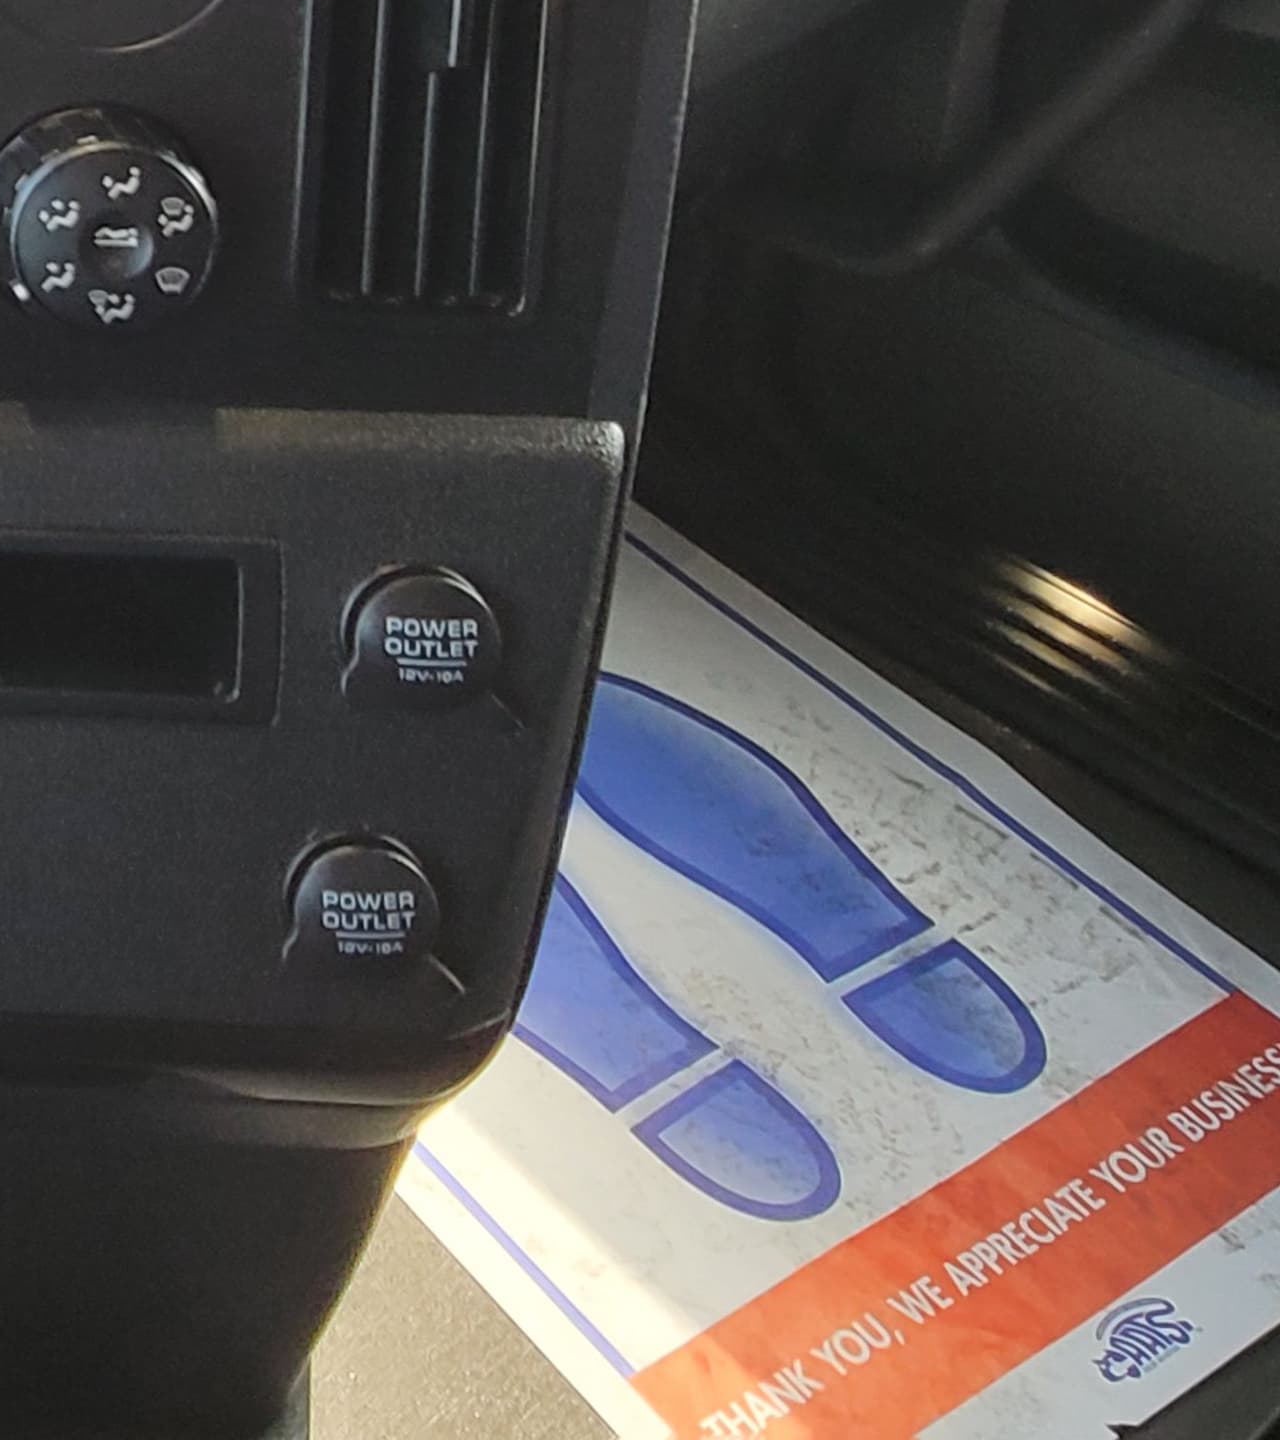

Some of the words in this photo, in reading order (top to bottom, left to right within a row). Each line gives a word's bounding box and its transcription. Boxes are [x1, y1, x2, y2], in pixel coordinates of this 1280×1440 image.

[386, 616, 478, 638] POWER
[384, 638, 478, 658] OUTLET
[322, 890, 416, 911] POWER
[322, 911, 416, 931] OUTLET
[699, 1359, 826, 1440] THANK
[809, 1312, 906, 1376] YOU,
[886, 1275, 955, 1324] WE
[944, 1177, 1107, 1297] APPRECIATE
[1088, 1126, 1186, 1194] YOUR
